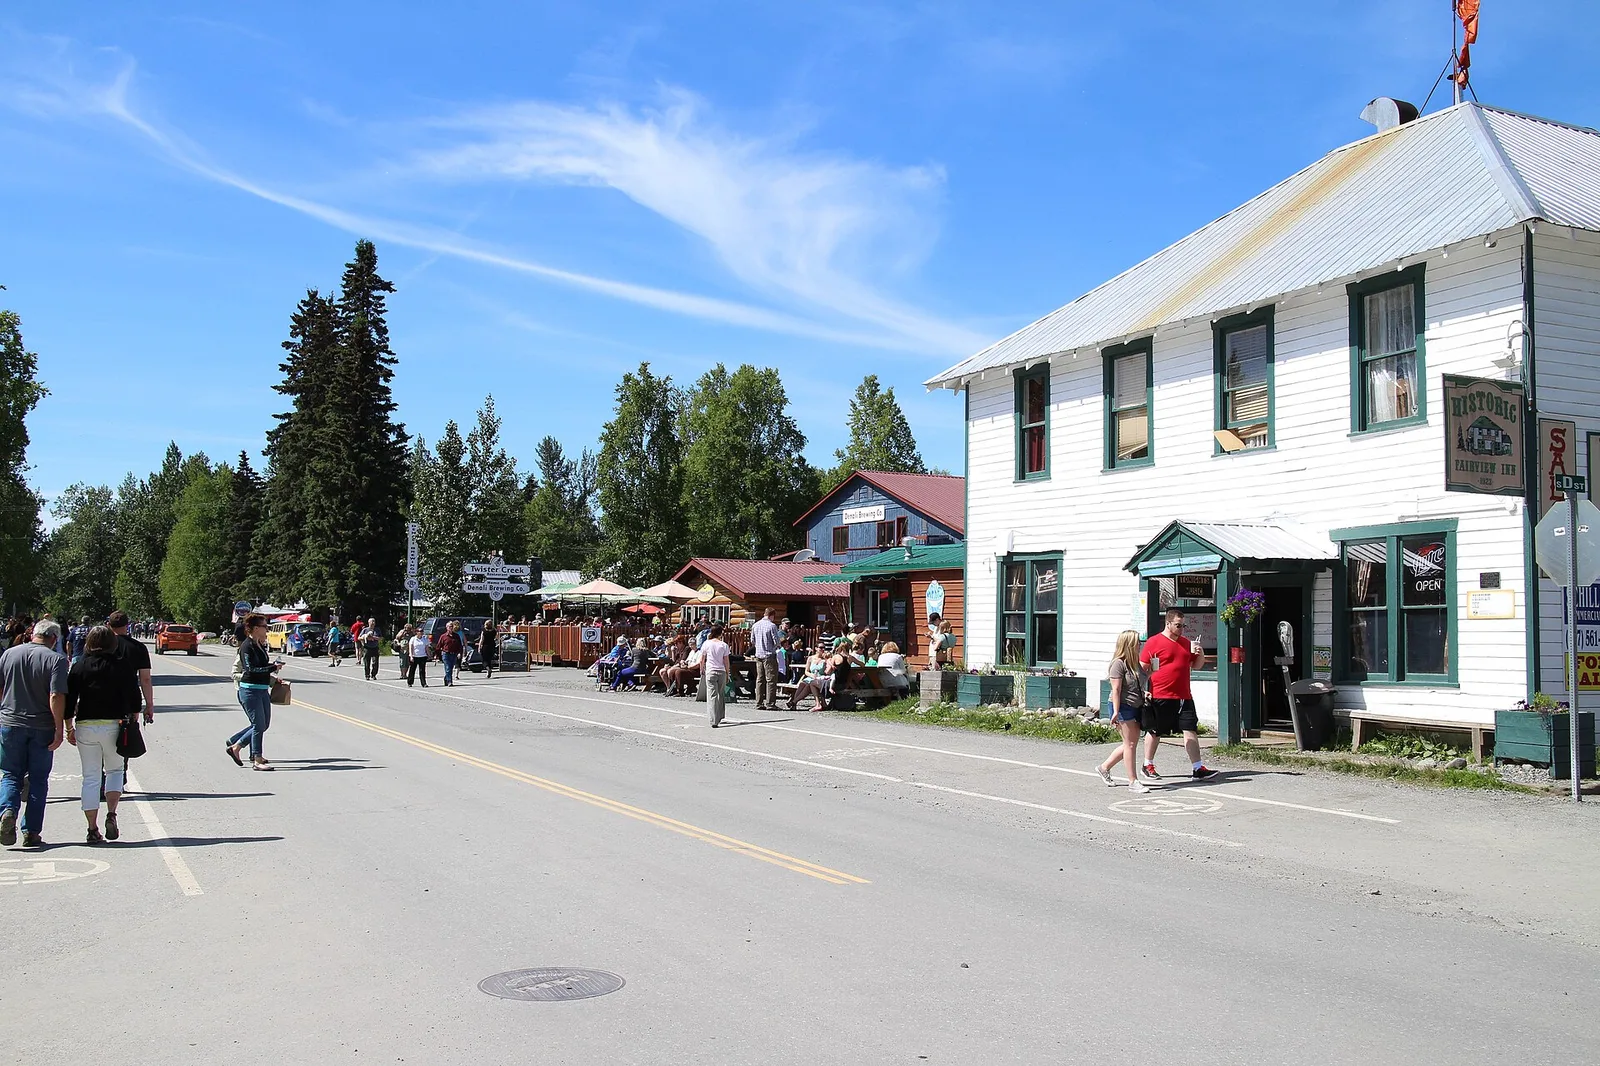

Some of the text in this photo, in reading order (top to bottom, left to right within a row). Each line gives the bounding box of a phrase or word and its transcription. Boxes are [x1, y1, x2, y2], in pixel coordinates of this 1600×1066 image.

[1451, 391, 1517, 423] HISTORIC
[1455, 459, 1516, 476] FAIRVIEW INN
[1549, 428, 1567, 502] SAL
[1556, 476, 1585, 490] S D ST
[501, 566, 525, 574] Creek
[489, 585, 515, 593] Brewing
[1415, 580, 1441, 591] OPEN
[1566, 629, 1584, 650] (7)
[1577, 655, 1600, 670] FO
[1568, 671, 1600, 686] AL
